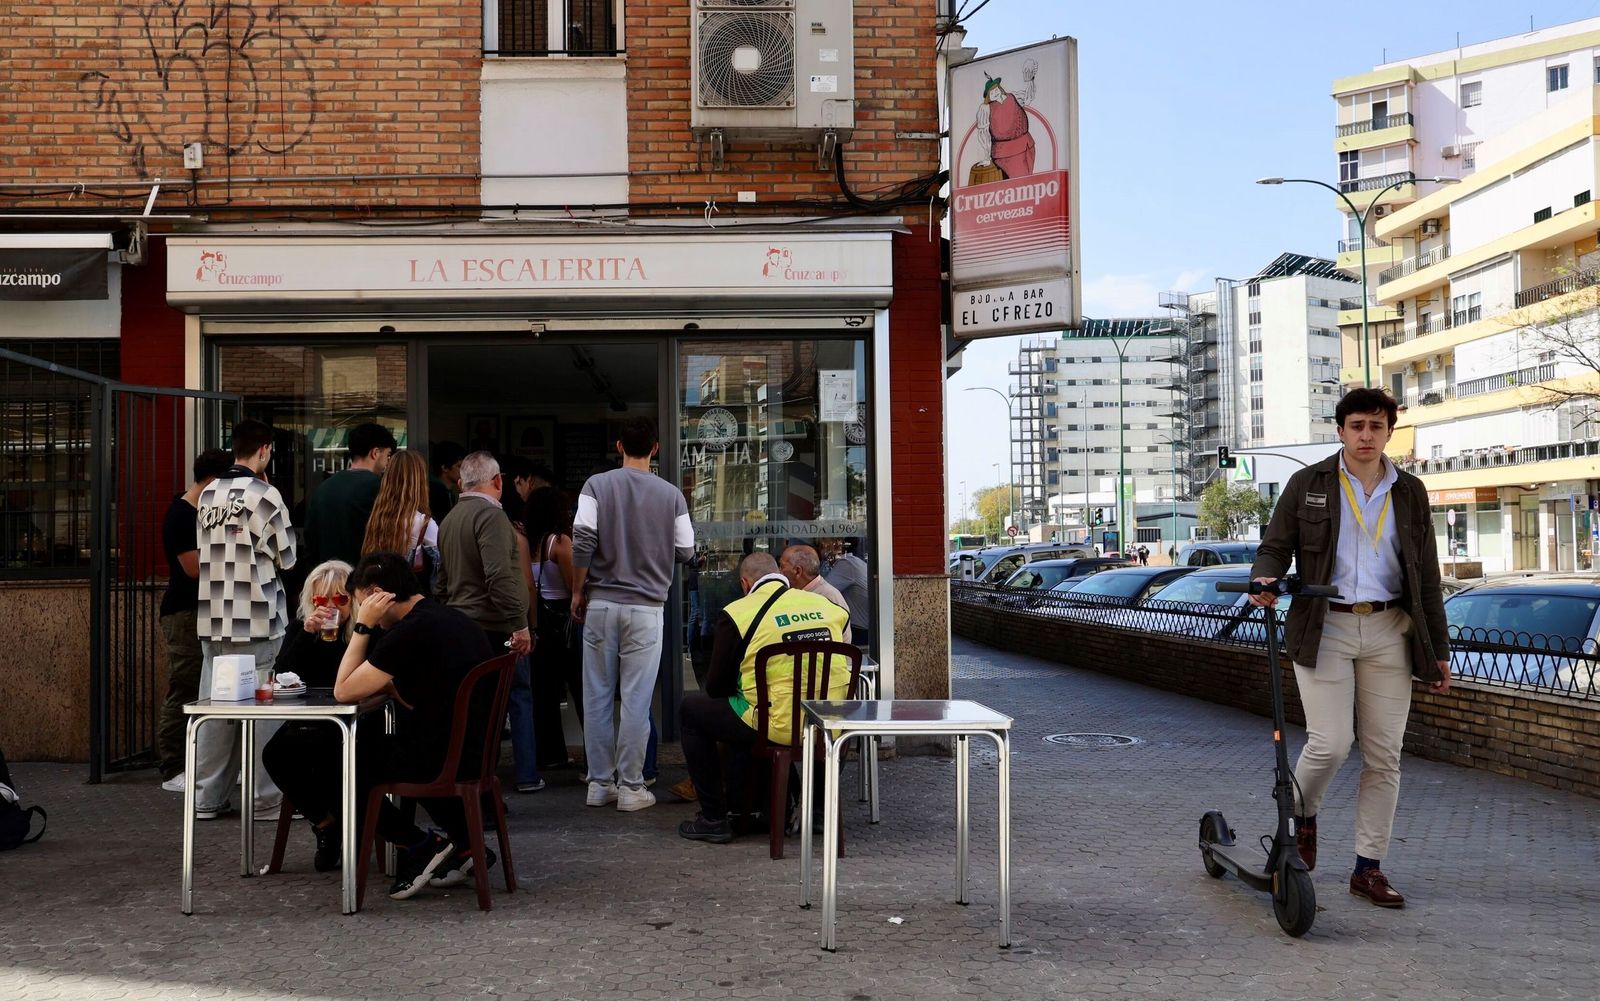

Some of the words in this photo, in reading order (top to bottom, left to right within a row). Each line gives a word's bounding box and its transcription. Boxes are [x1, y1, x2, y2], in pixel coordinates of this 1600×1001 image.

[954, 180, 1059, 213] Cruzcampo
[976, 206, 1034, 224] cervezas
[408, 259, 449, 282] LA
[461, 257, 648, 282] ESCALERITA
[218, 272, 282, 286] Cruzcampo
[1023, 288, 1044, 300] BAR
[962, 310, 978, 326] EL
[791, 611, 824, 622] ONCE
[797, 632, 814, 641] grupo
